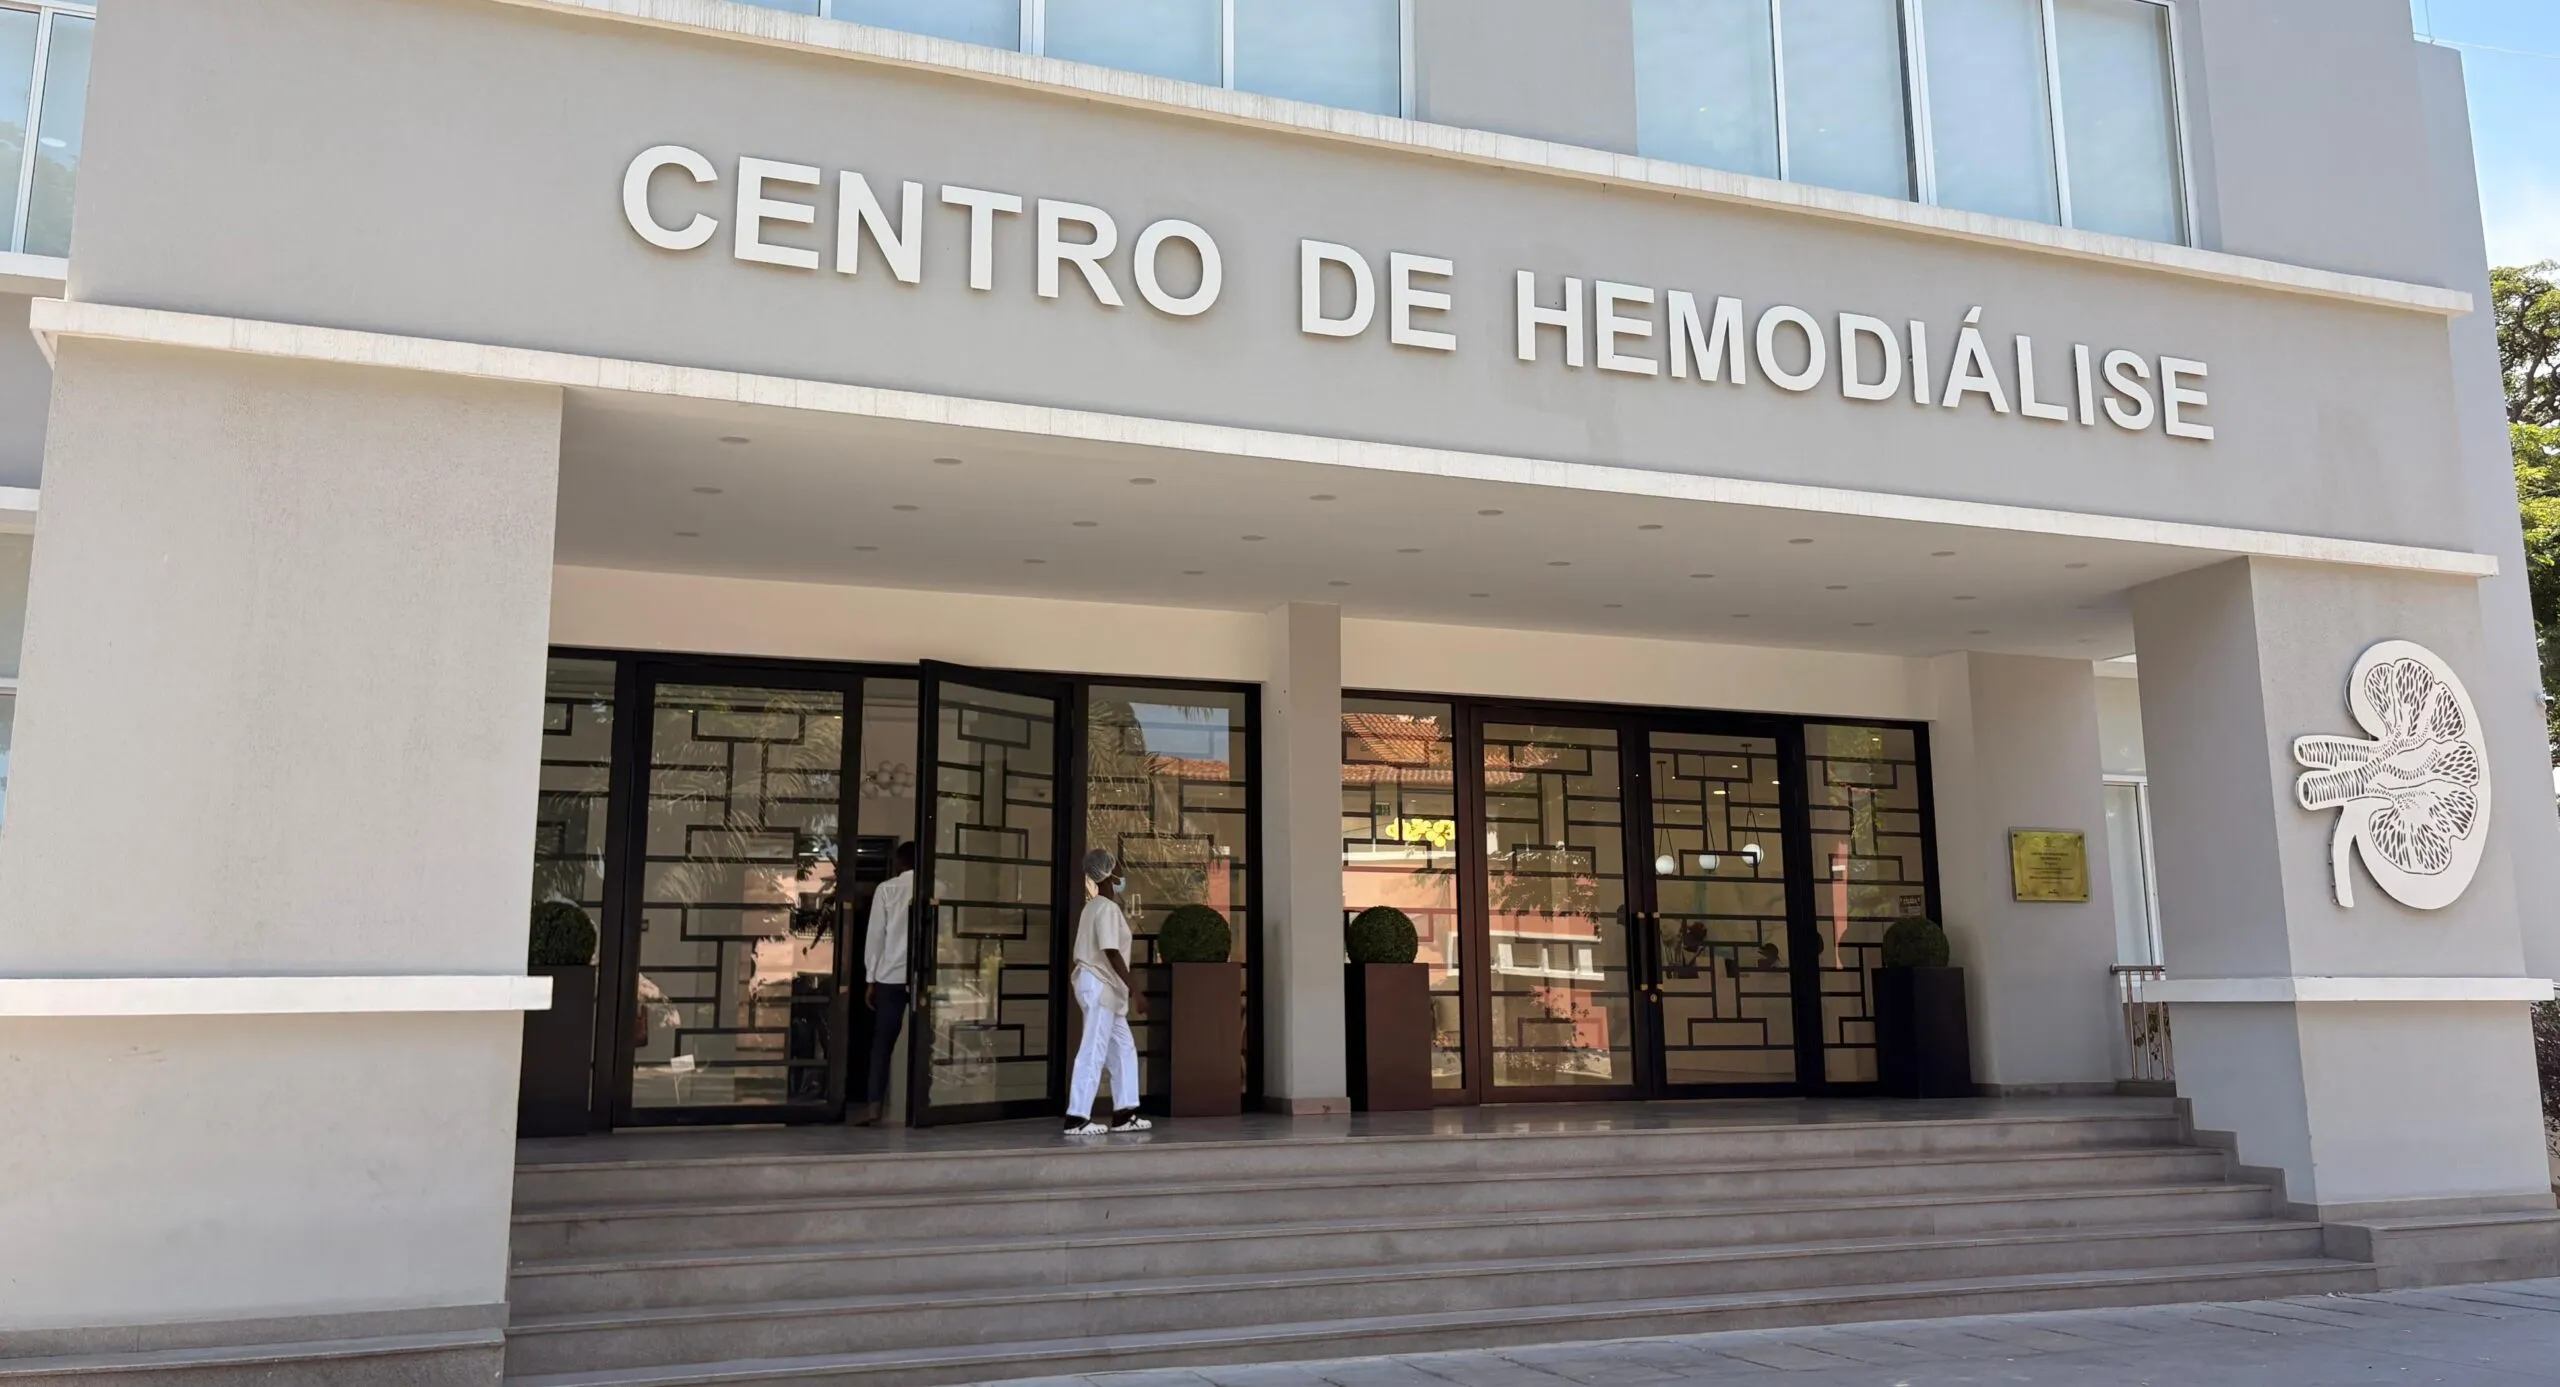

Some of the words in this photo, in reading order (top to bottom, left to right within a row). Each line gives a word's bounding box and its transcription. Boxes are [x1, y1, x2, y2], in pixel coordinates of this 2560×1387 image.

[621, 144, 1223, 316] CENTRO
[1300, 239, 1457, 351] DE
[1516, 270, 2216, 440] HEMODIÁLISE
